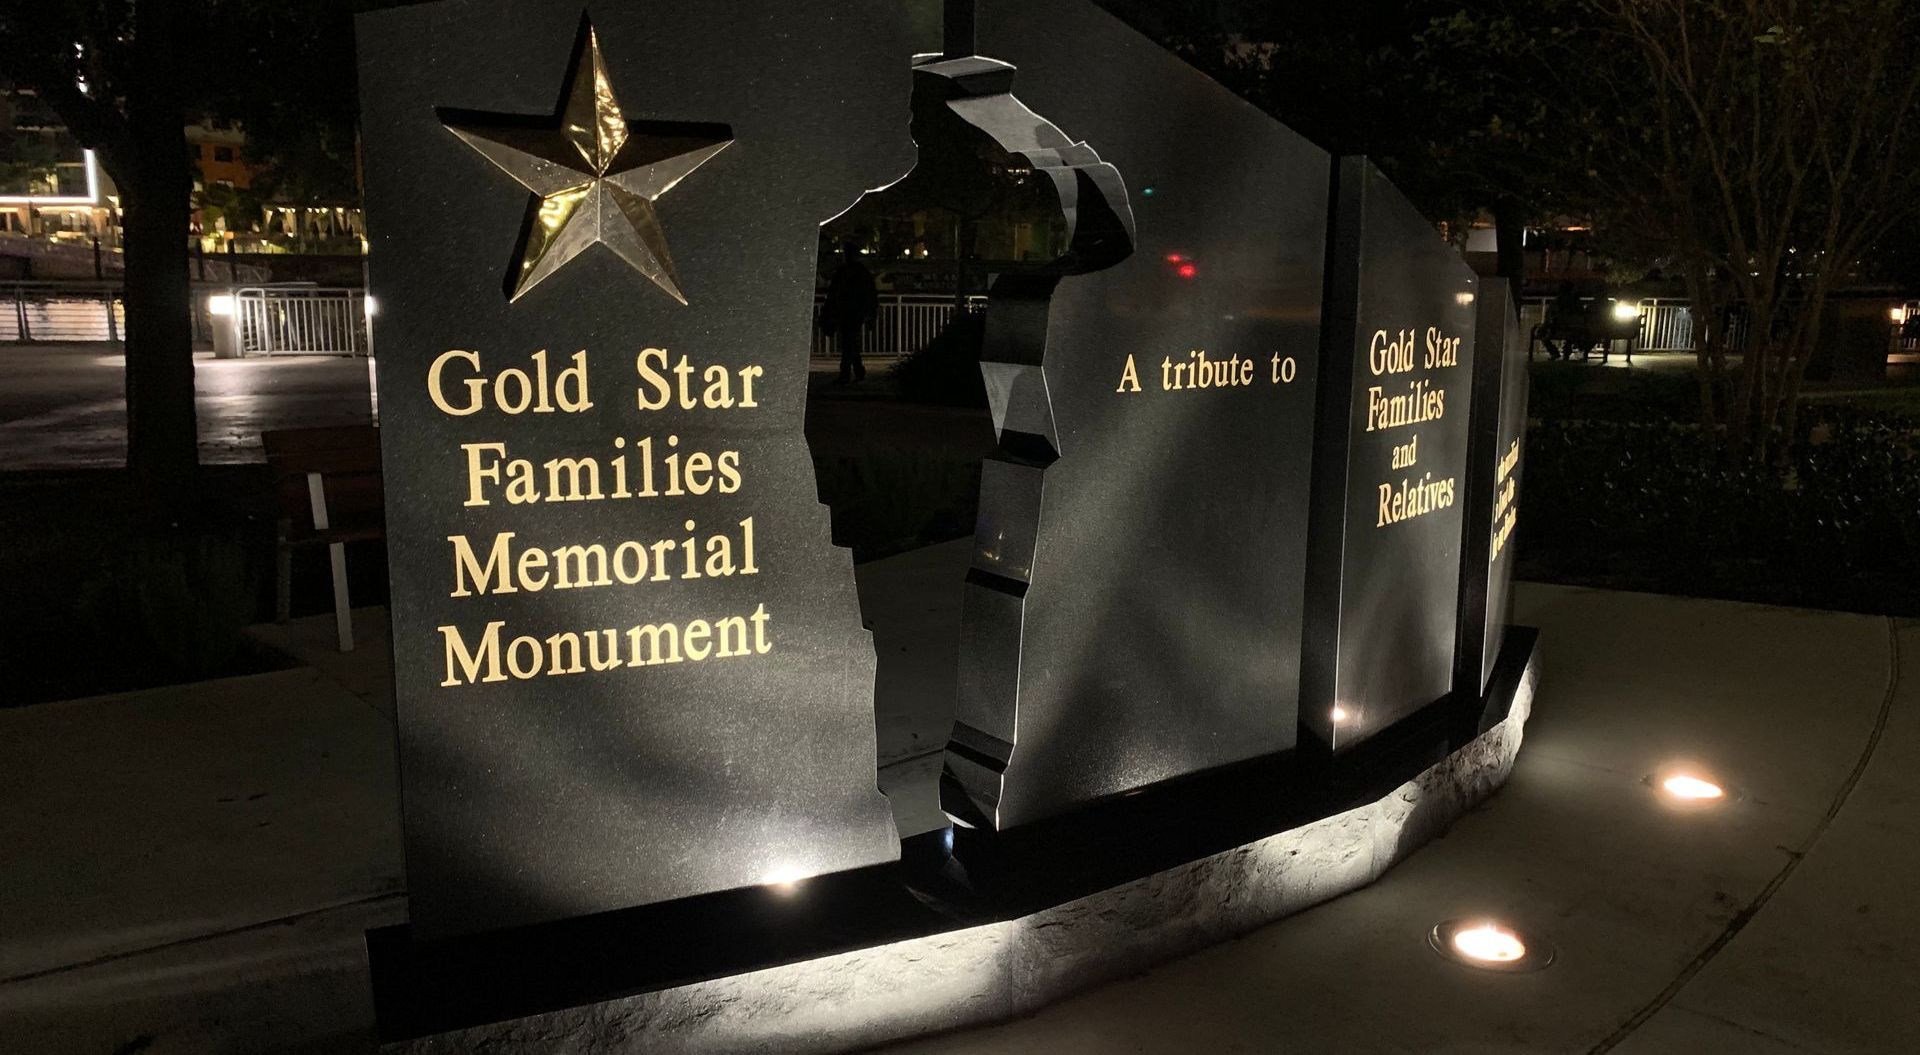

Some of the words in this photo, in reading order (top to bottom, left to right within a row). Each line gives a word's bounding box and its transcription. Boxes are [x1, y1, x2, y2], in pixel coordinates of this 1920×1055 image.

[1116, 353, 1142, 393] A
[1161, 349, 1254, 391] tribute
[1270, 351, 1296, 384] to
[1369, 328, 1415, 376] Gold
[1424, 326, 1461, 370] Star
[427, 349, 594, 416] Gold
[636, 347, 764, 411] Star
[1366, 379, 1445, 432] Families
[460, 434, 742, 507] Families
[1391, 434, 1418, 471] and
[1376, 471, 1455, 529] Relatives
[446, 516, 760, 598] Memorial
[437, 602, 773, 688] Monument
